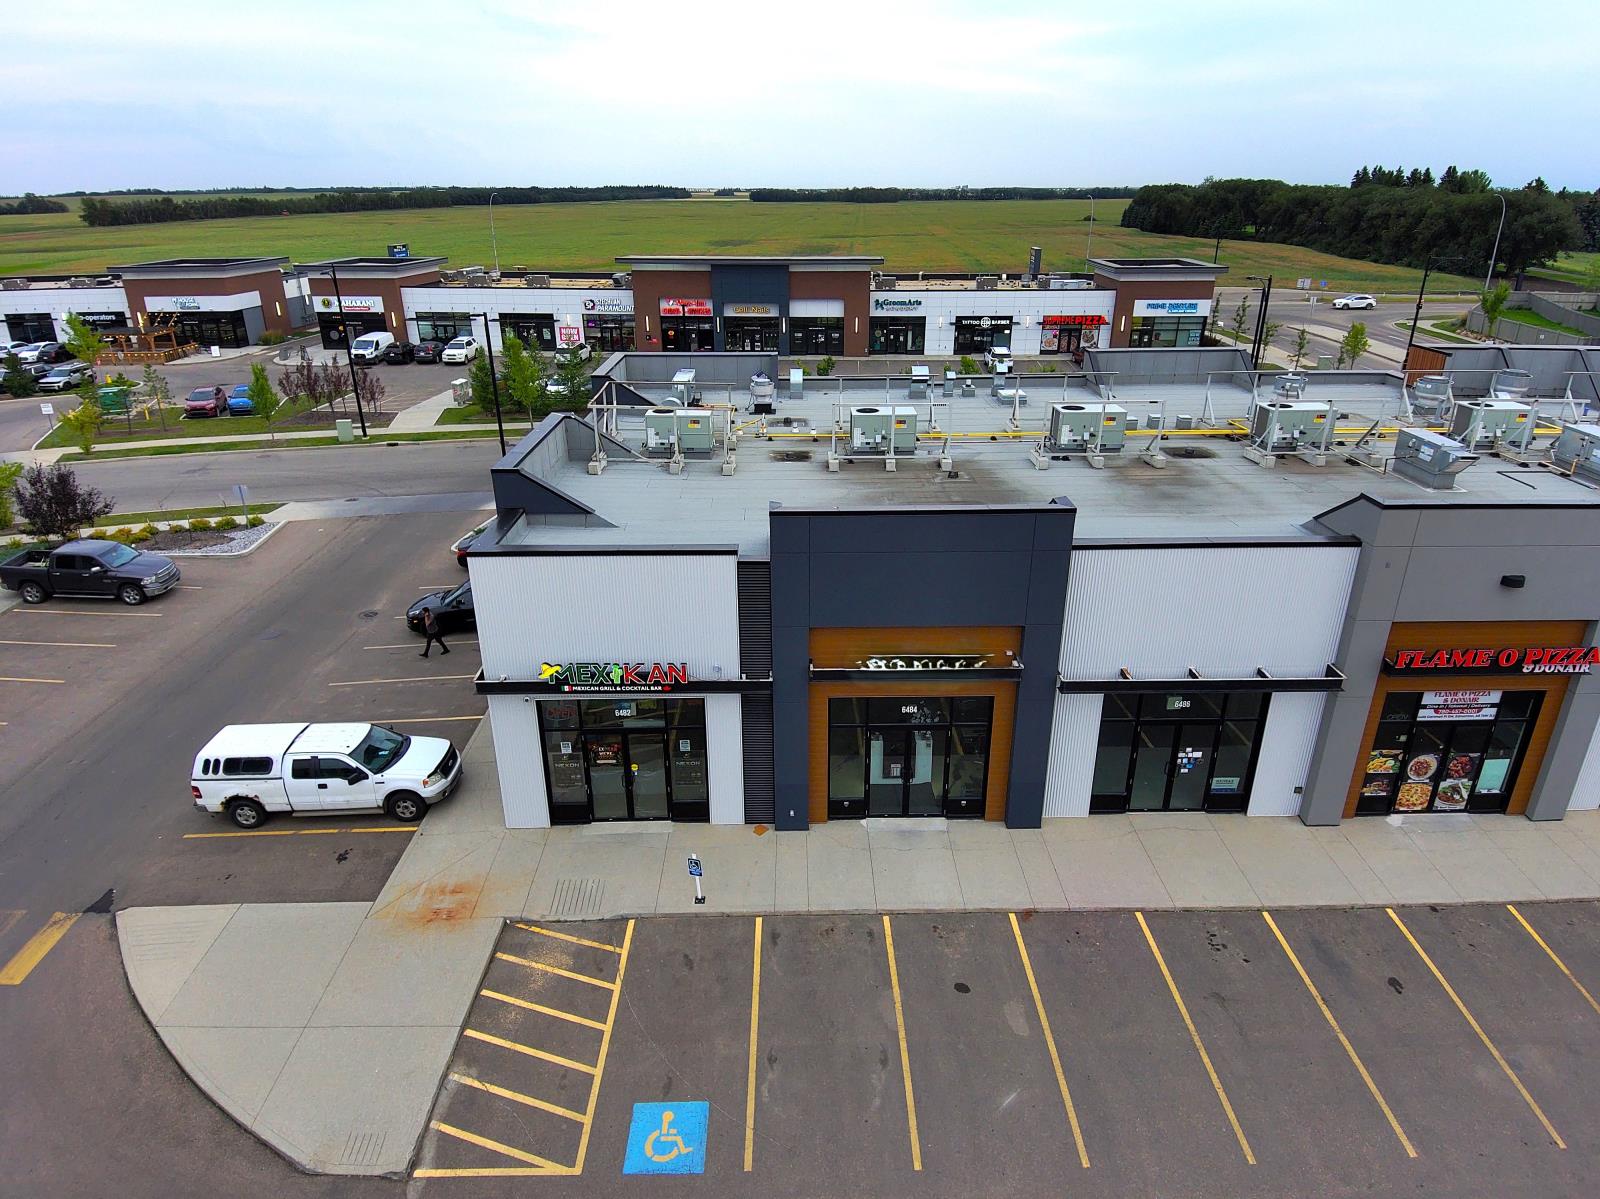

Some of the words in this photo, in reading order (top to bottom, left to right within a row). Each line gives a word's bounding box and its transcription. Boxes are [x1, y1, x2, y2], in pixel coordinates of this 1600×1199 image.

[1075, 315, 1108, 325] PIZZA
[1395, 650, 1493, 668] FLAME
[1498, 648, 1519, 667] O
[1523, 647, 1600, 666] PIZZA
[548, 662, 688, 684] MEXIKAN
[1534, 664, 1590, 673] DONAIR
[614, 709, 632, 717] 6482
